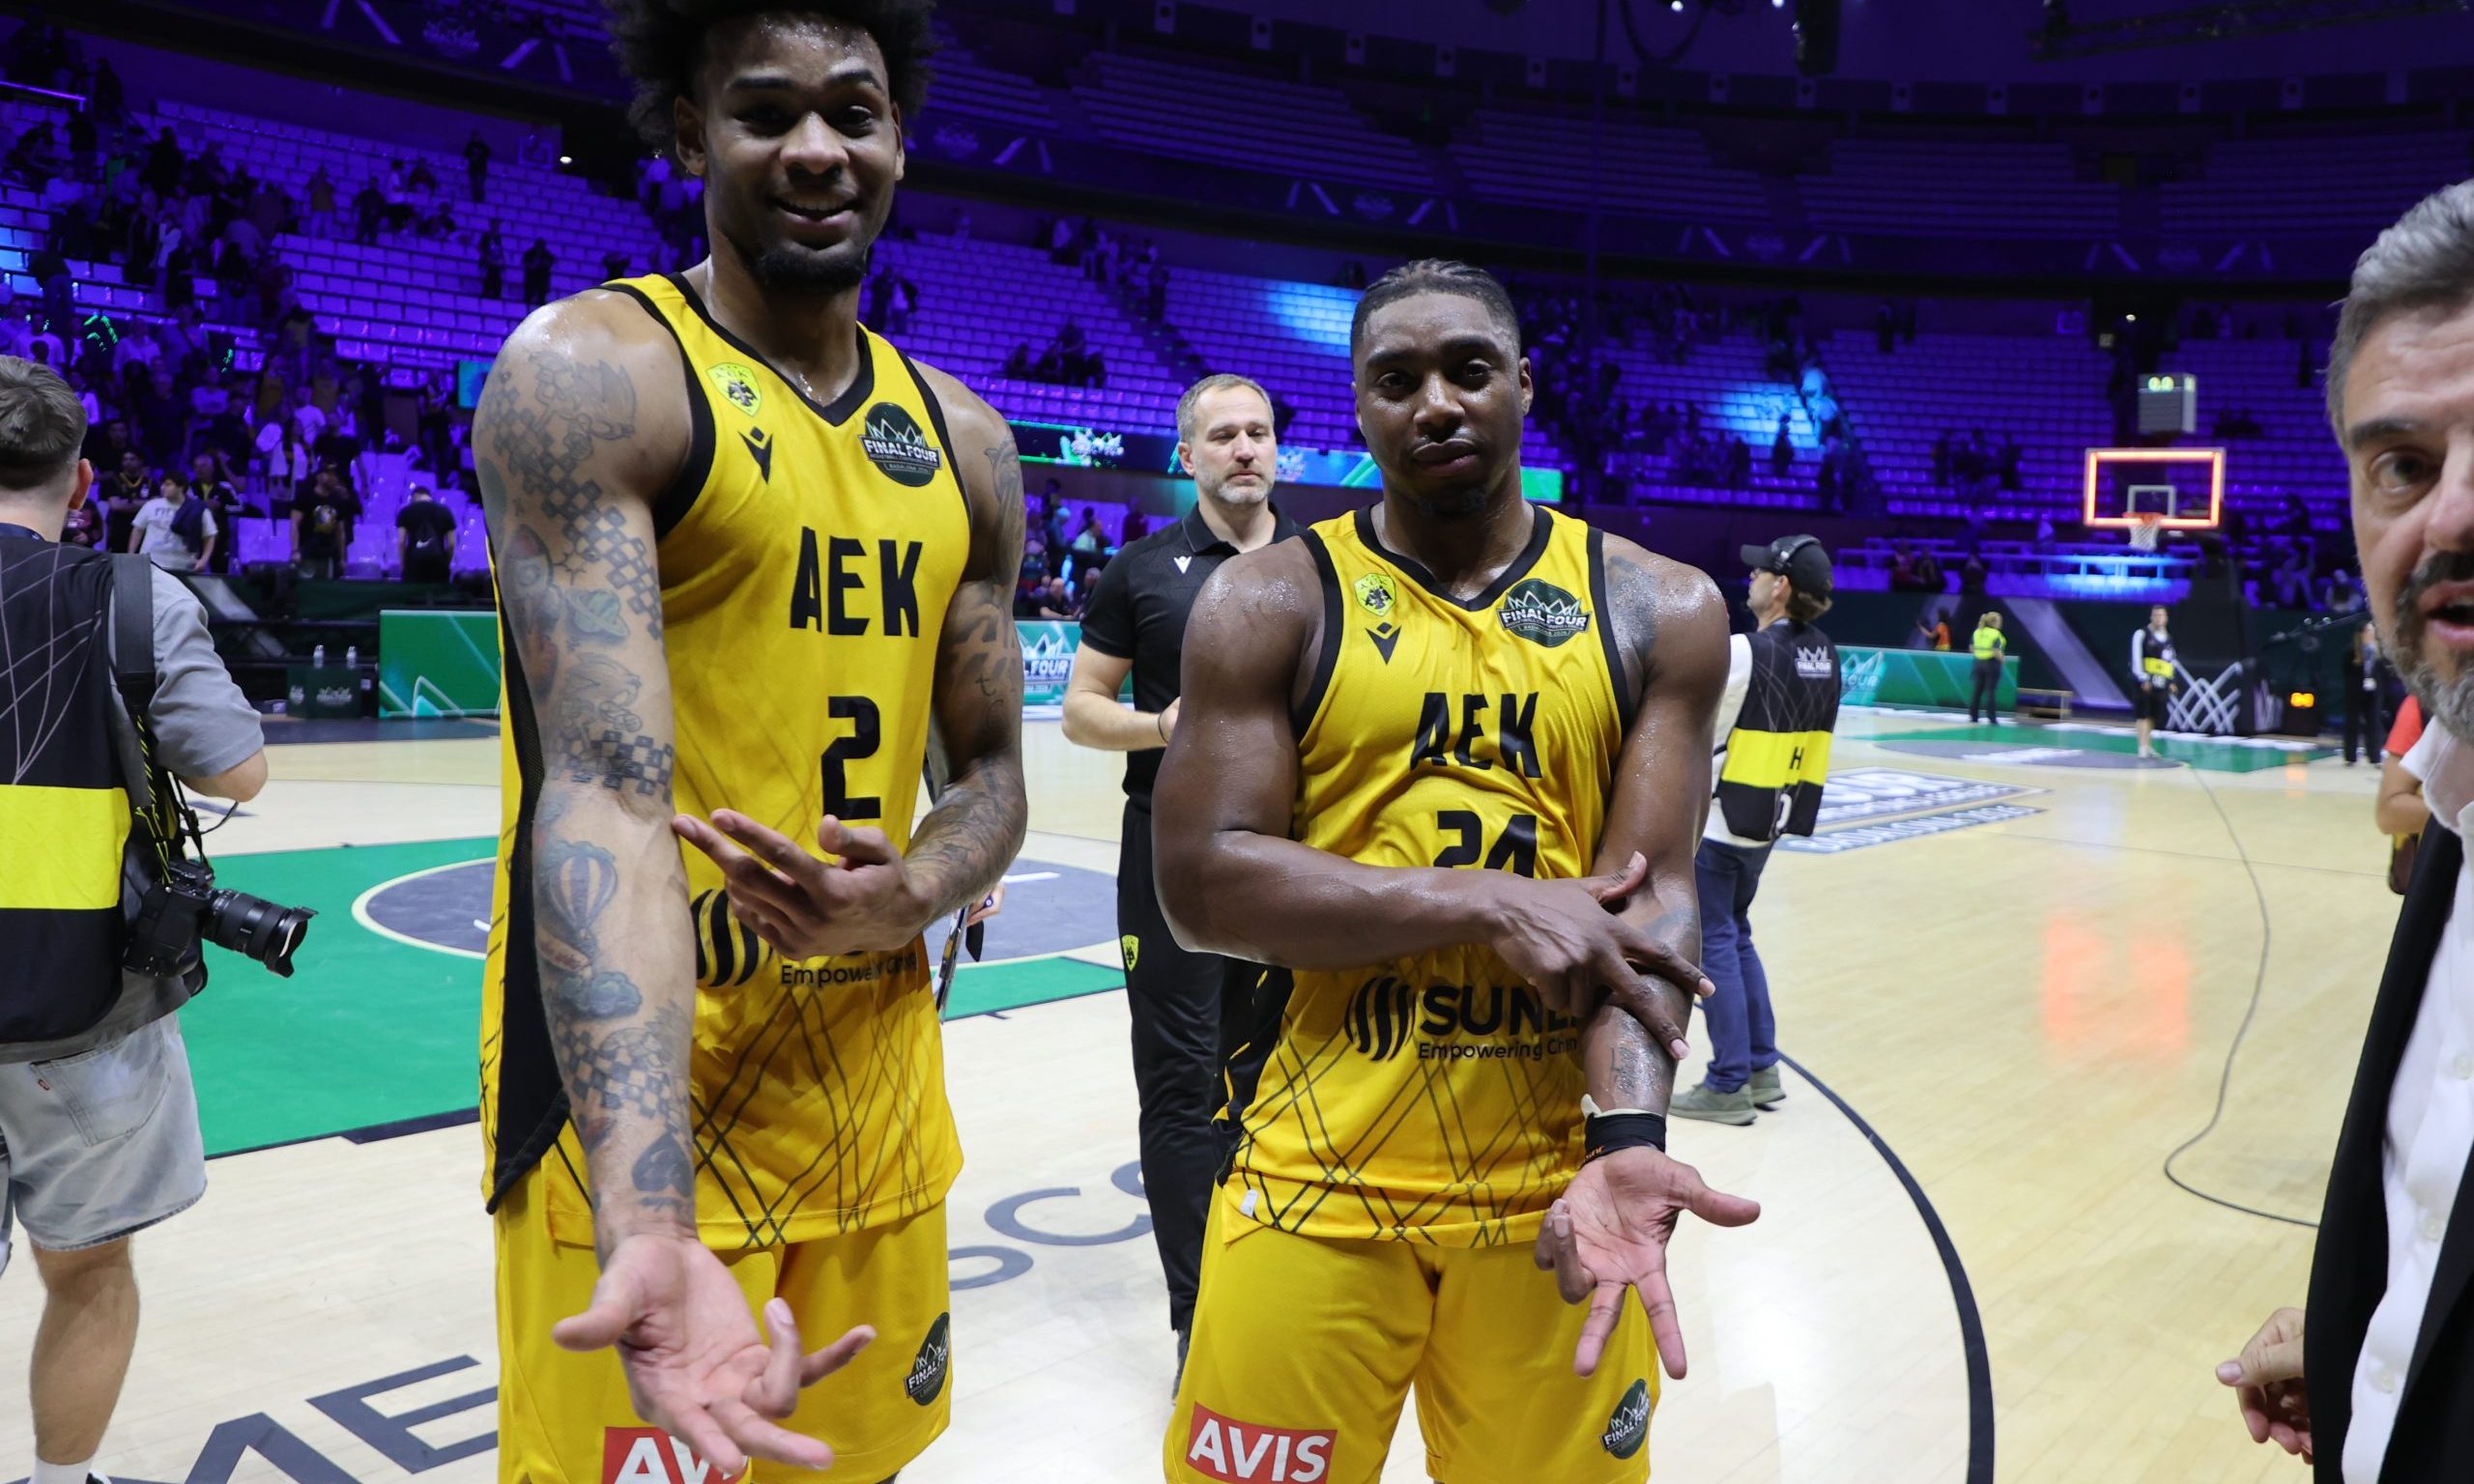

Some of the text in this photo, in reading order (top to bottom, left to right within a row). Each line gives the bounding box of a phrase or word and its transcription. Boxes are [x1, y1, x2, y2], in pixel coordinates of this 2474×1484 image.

[863, 440, 906, 457] FINAL
[906, 444, 938, 463] FOUR
[790, 526, 924, 638] AEK
[1501, 608, 1546, 623] FINAL
[1546, 614, 1588, 627] FOUR
[1030, 660, 1070, 675] FOUR
[1410, 692, 1543, 779] AEK
[821, 696, 881, 820] 2
[1419, 1041, 1543, 1062] Empowering
[908, 1361, 937, 1389] FINAL
[1604, 1421, 1634, 1445] FINAL
[1189, 1417, 1331, 1483] AVIS
